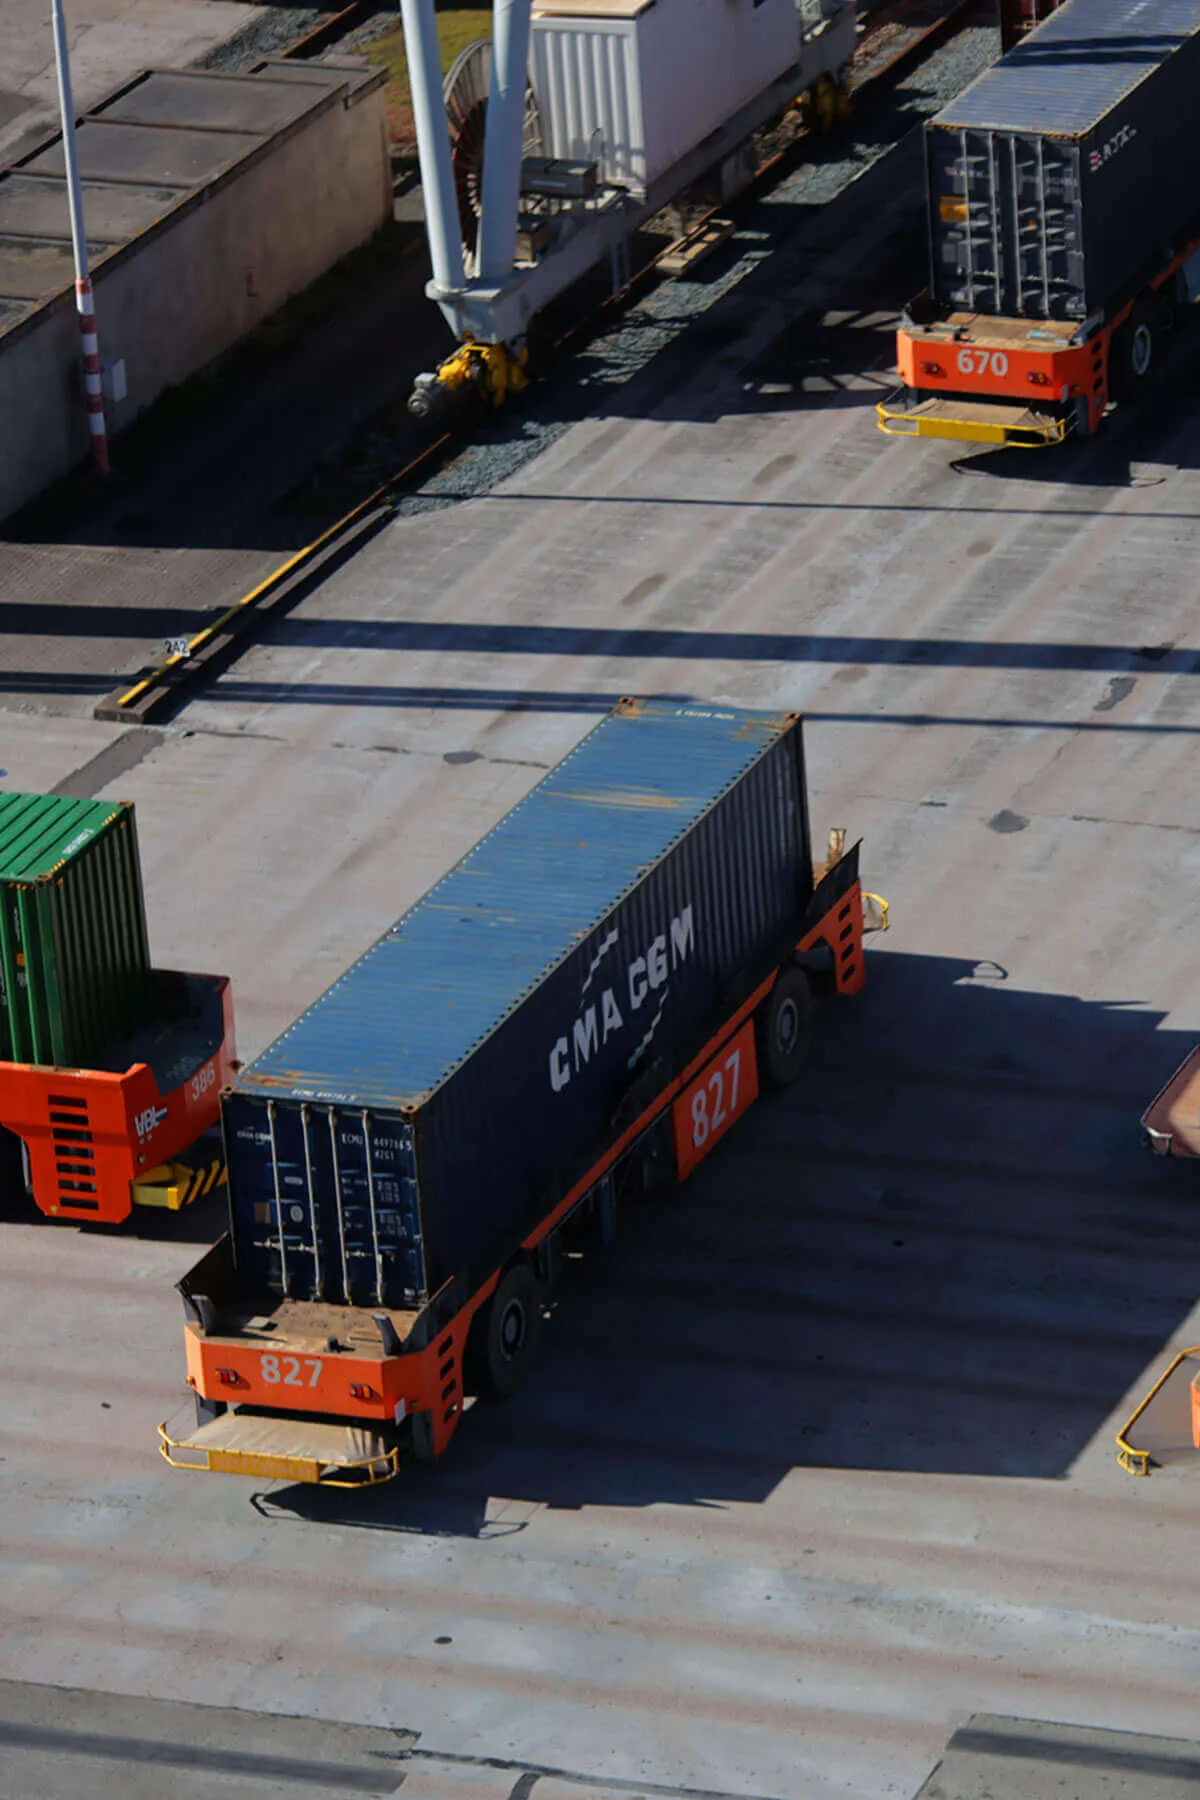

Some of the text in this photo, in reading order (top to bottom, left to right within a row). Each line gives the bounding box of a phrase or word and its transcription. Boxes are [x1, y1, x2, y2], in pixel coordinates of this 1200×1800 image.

[957, 349, 1009, 376] 670
[549, 903, 696, 1093] CMA CGM
[191, 1060, 216, 1102] 386
[690, 1048, 741, 1147] 827
[259, 1354, 324, 1389] 827
[212, 1454, 314, 1477] GOTTWALD
